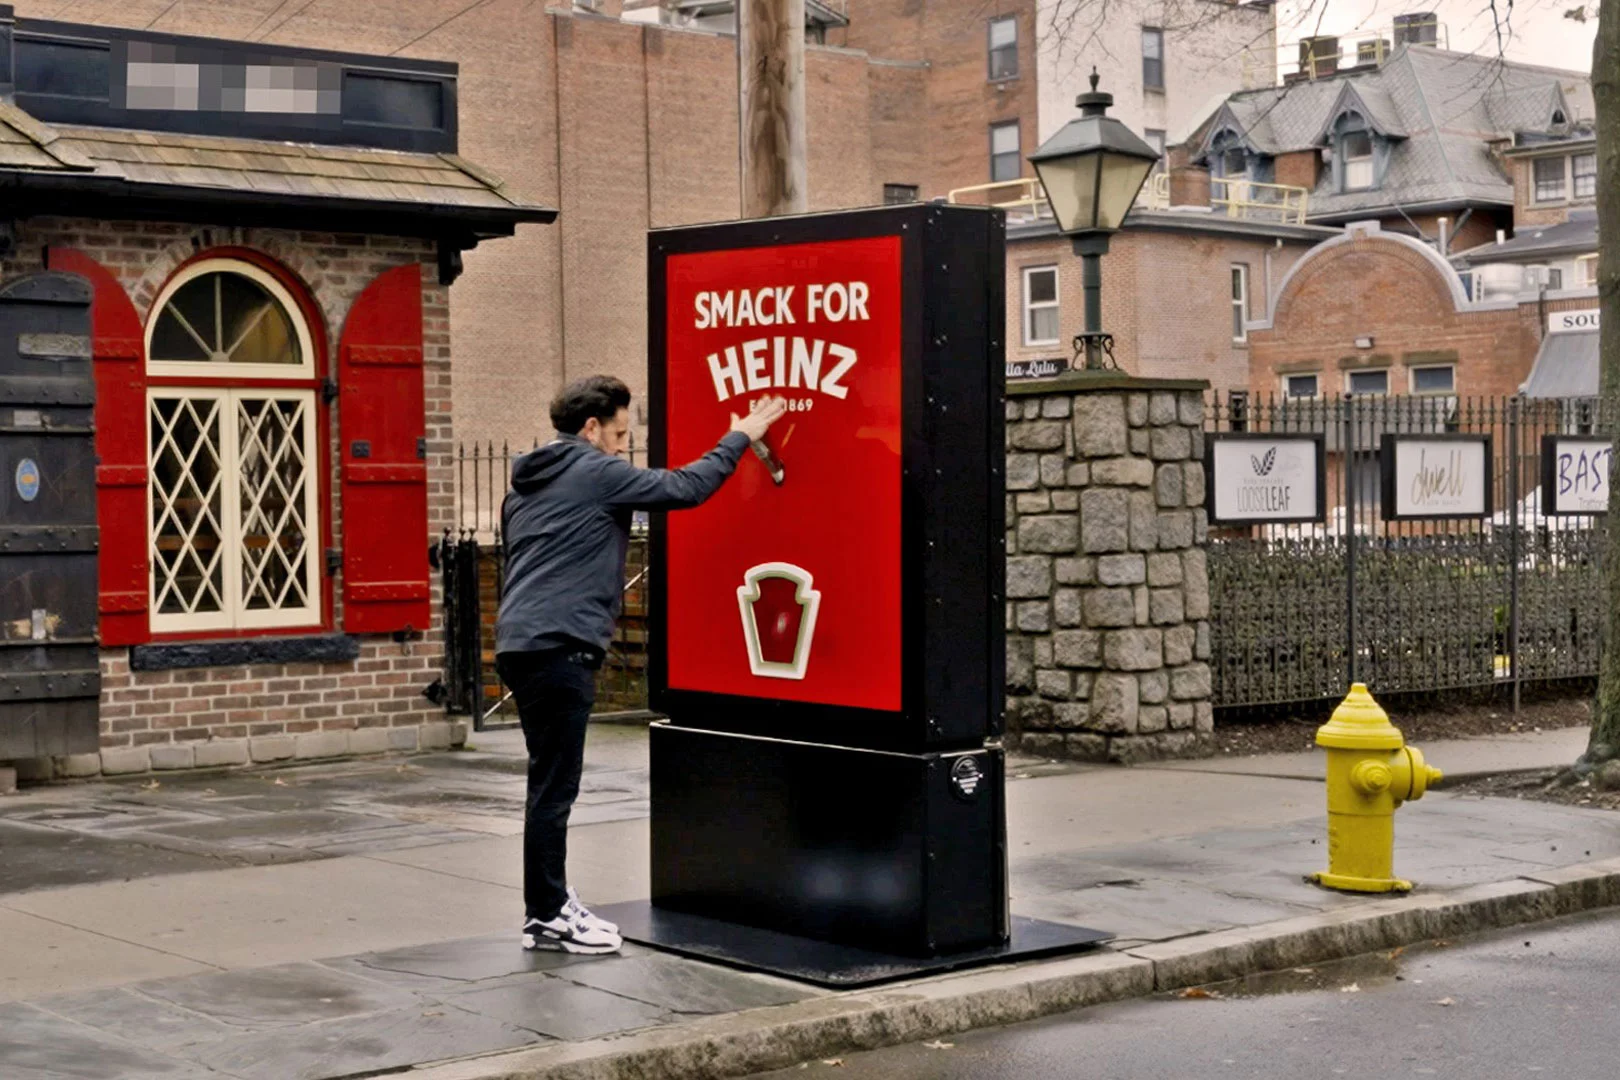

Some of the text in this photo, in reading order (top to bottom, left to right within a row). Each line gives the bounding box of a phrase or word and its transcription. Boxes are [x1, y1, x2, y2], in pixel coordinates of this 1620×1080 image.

[694, 281, 870, 330] SMACK FOR
[706, 336, 858, 402] HEINZ
[1026, 360, 1058, 378] Lulu
[1237, 485, 1291, 512] LOOSELEAF
[1410, 447, 1467, 506] dwell
